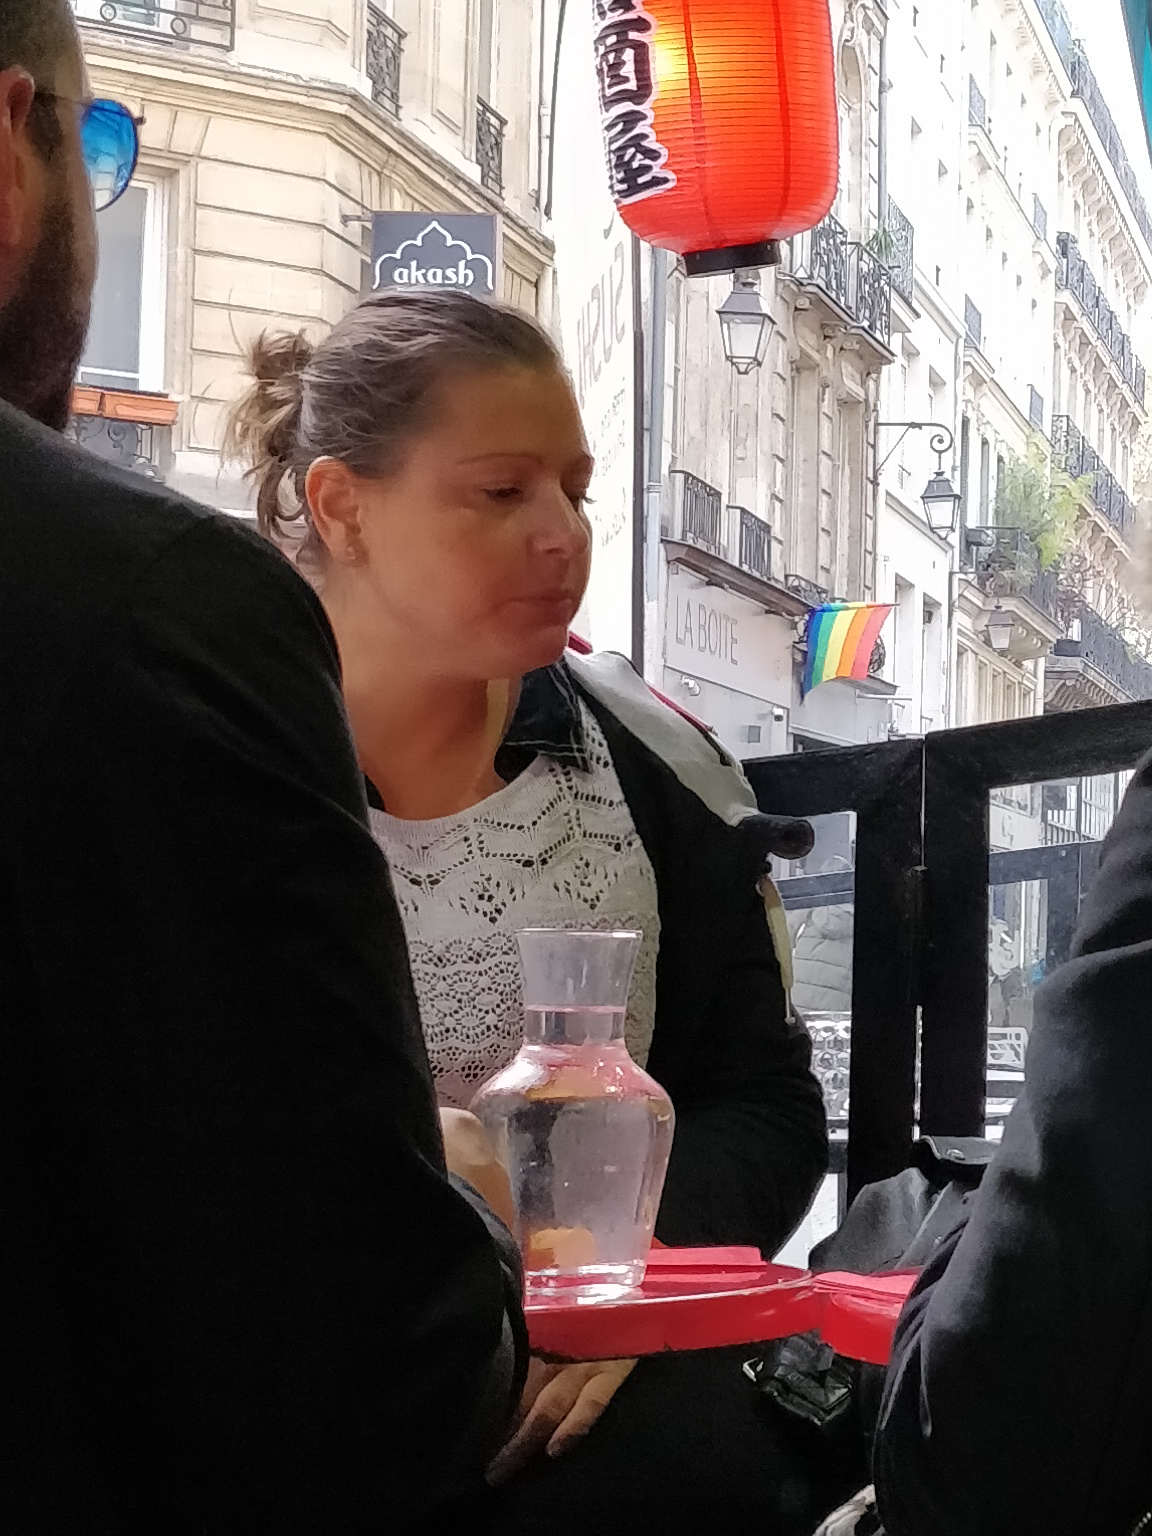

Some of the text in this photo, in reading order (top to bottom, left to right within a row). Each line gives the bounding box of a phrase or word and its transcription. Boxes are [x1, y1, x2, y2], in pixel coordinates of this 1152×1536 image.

[393, 259, 475, 287] akash
[675, 593, 738, 665] LA BOITE
